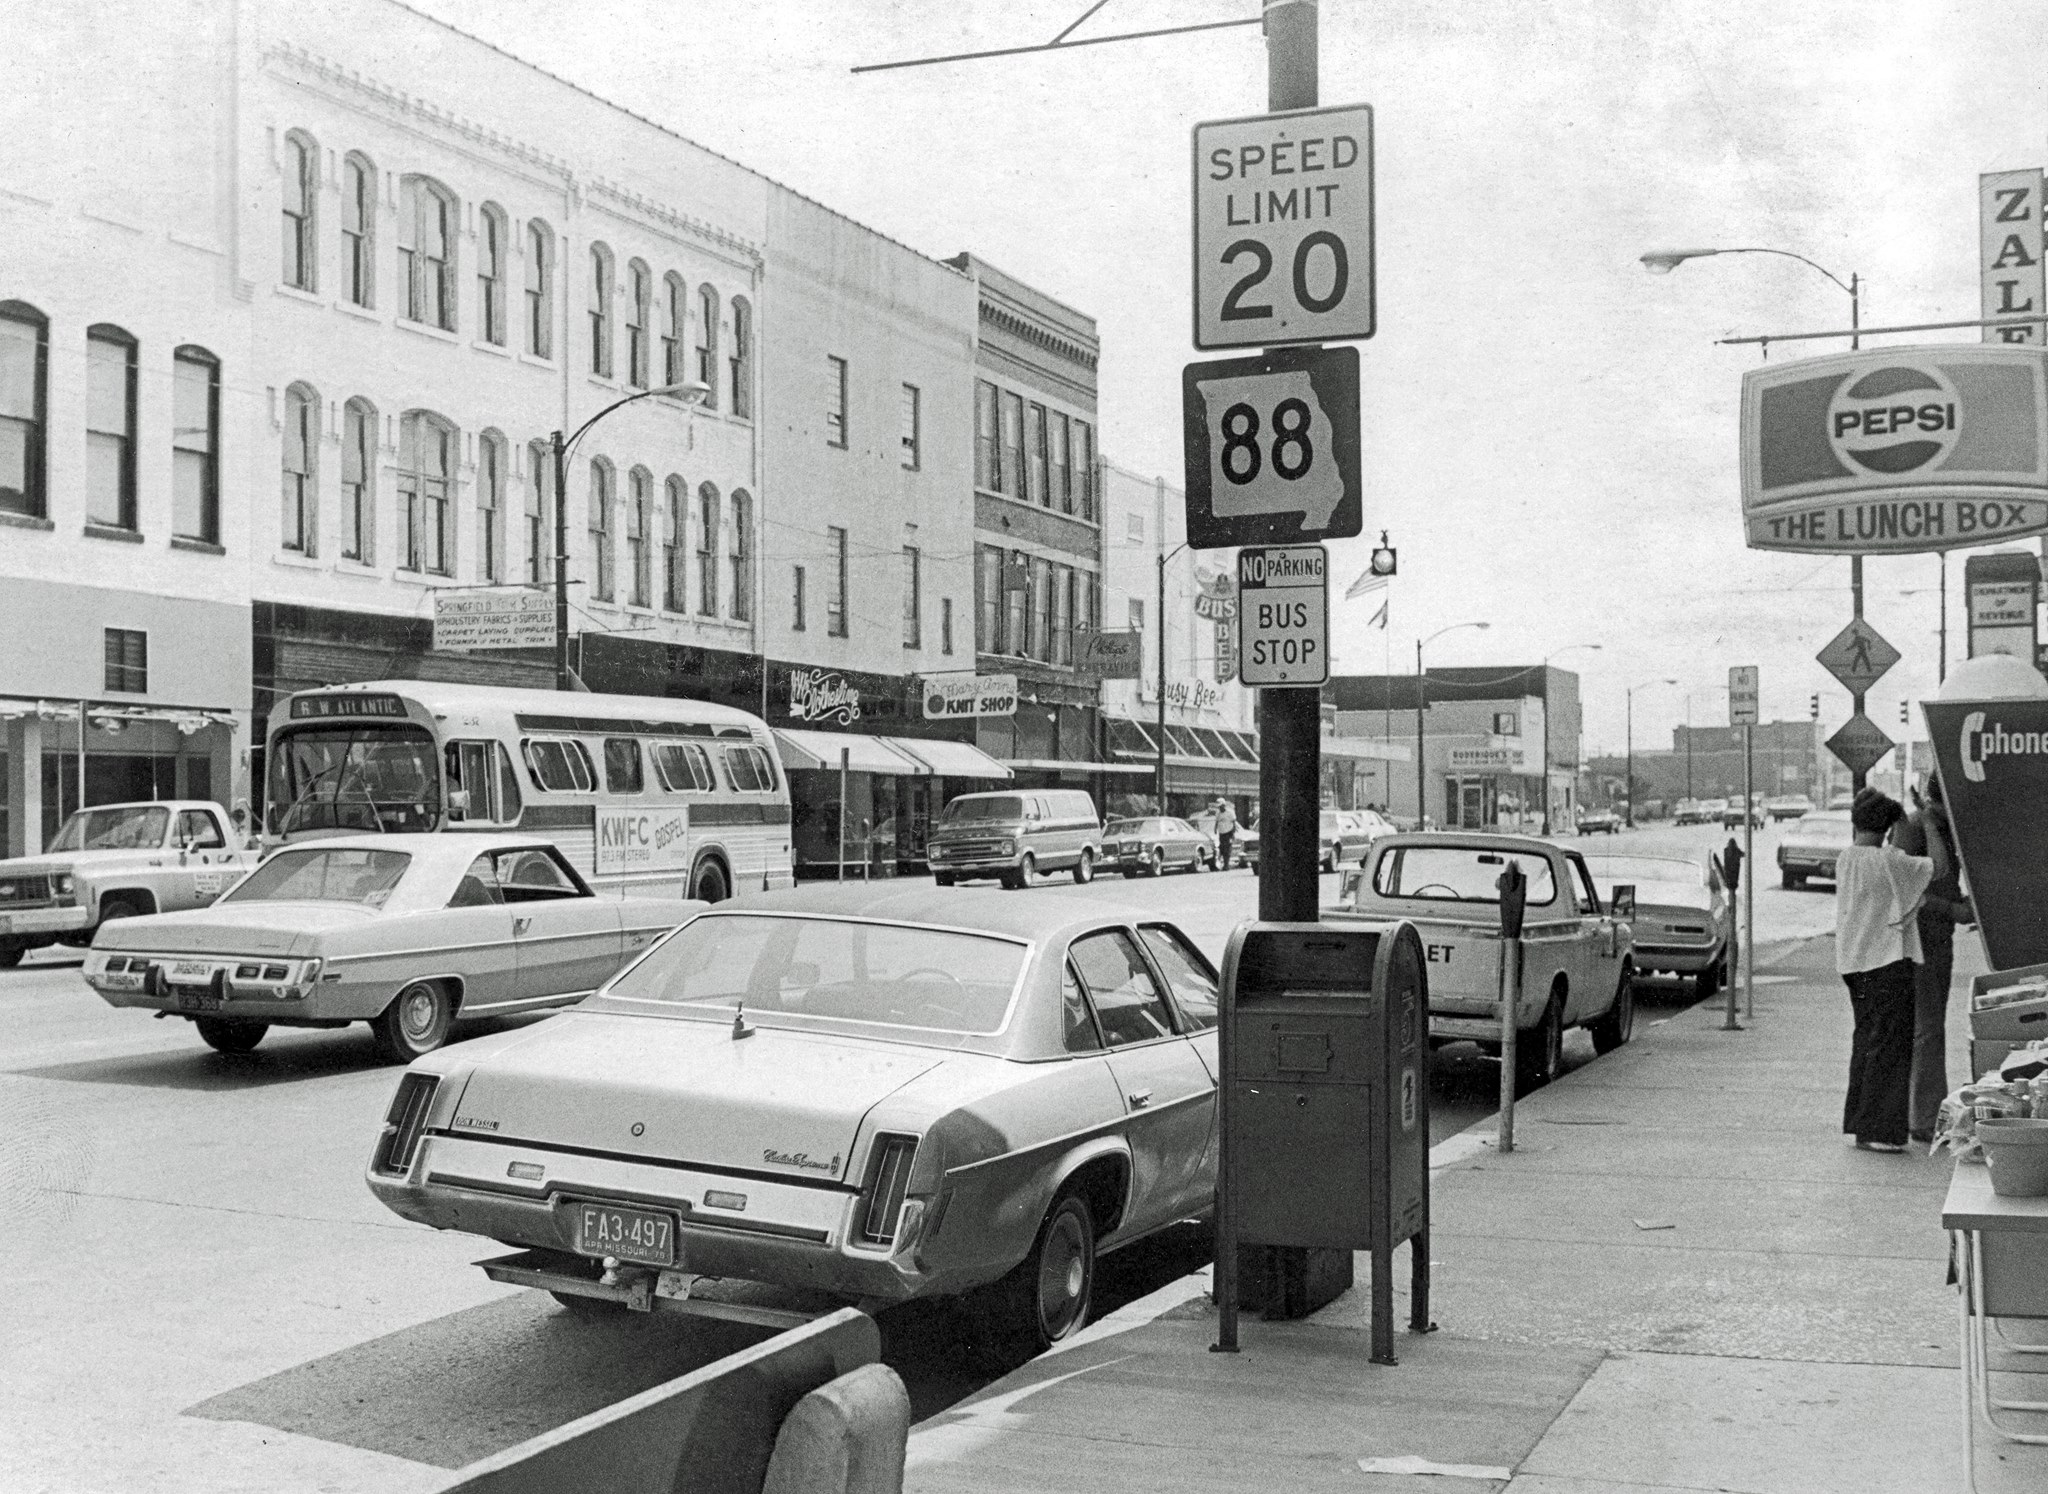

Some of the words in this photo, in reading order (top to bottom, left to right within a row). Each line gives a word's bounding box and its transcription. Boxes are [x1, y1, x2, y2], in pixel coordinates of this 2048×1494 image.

[1209, 135, 1359, 181] SPEED
[1227, 184, 1340, 227] LIMIT
[1219, 230, 1349, 322] 20
[1834, 403, 1956, 439] PEPSI
[1220, 397, 1314, 486] 88
[1768, 510, 1826, 541] THE
[1837, 502, 1944, 541] LUNCH
[1957, 502, 2028, 534] BOX
[1241, 556, 1265, 582] NO
[1267, 558, 1323, 577] PARKING
[519, 612, 553, 624] SUPPLIES
[1196, 600, 1237, 618] BUS
[1259, 602, 1308, 629] BUS
[1252, 638, 1317, 666] STOP
[338, 699, 398, 715] ATLANTIC
[946, 698, 976, 714] KNIT
[980, 694, 1014, 712] SHOP
[1158, 682, 1189, 716] usy
[601, 816, 649, 847] KWFC
[655, 816, 685, 850] GOSPEL
[604, 1243, 648, 1257] MISSOURI
